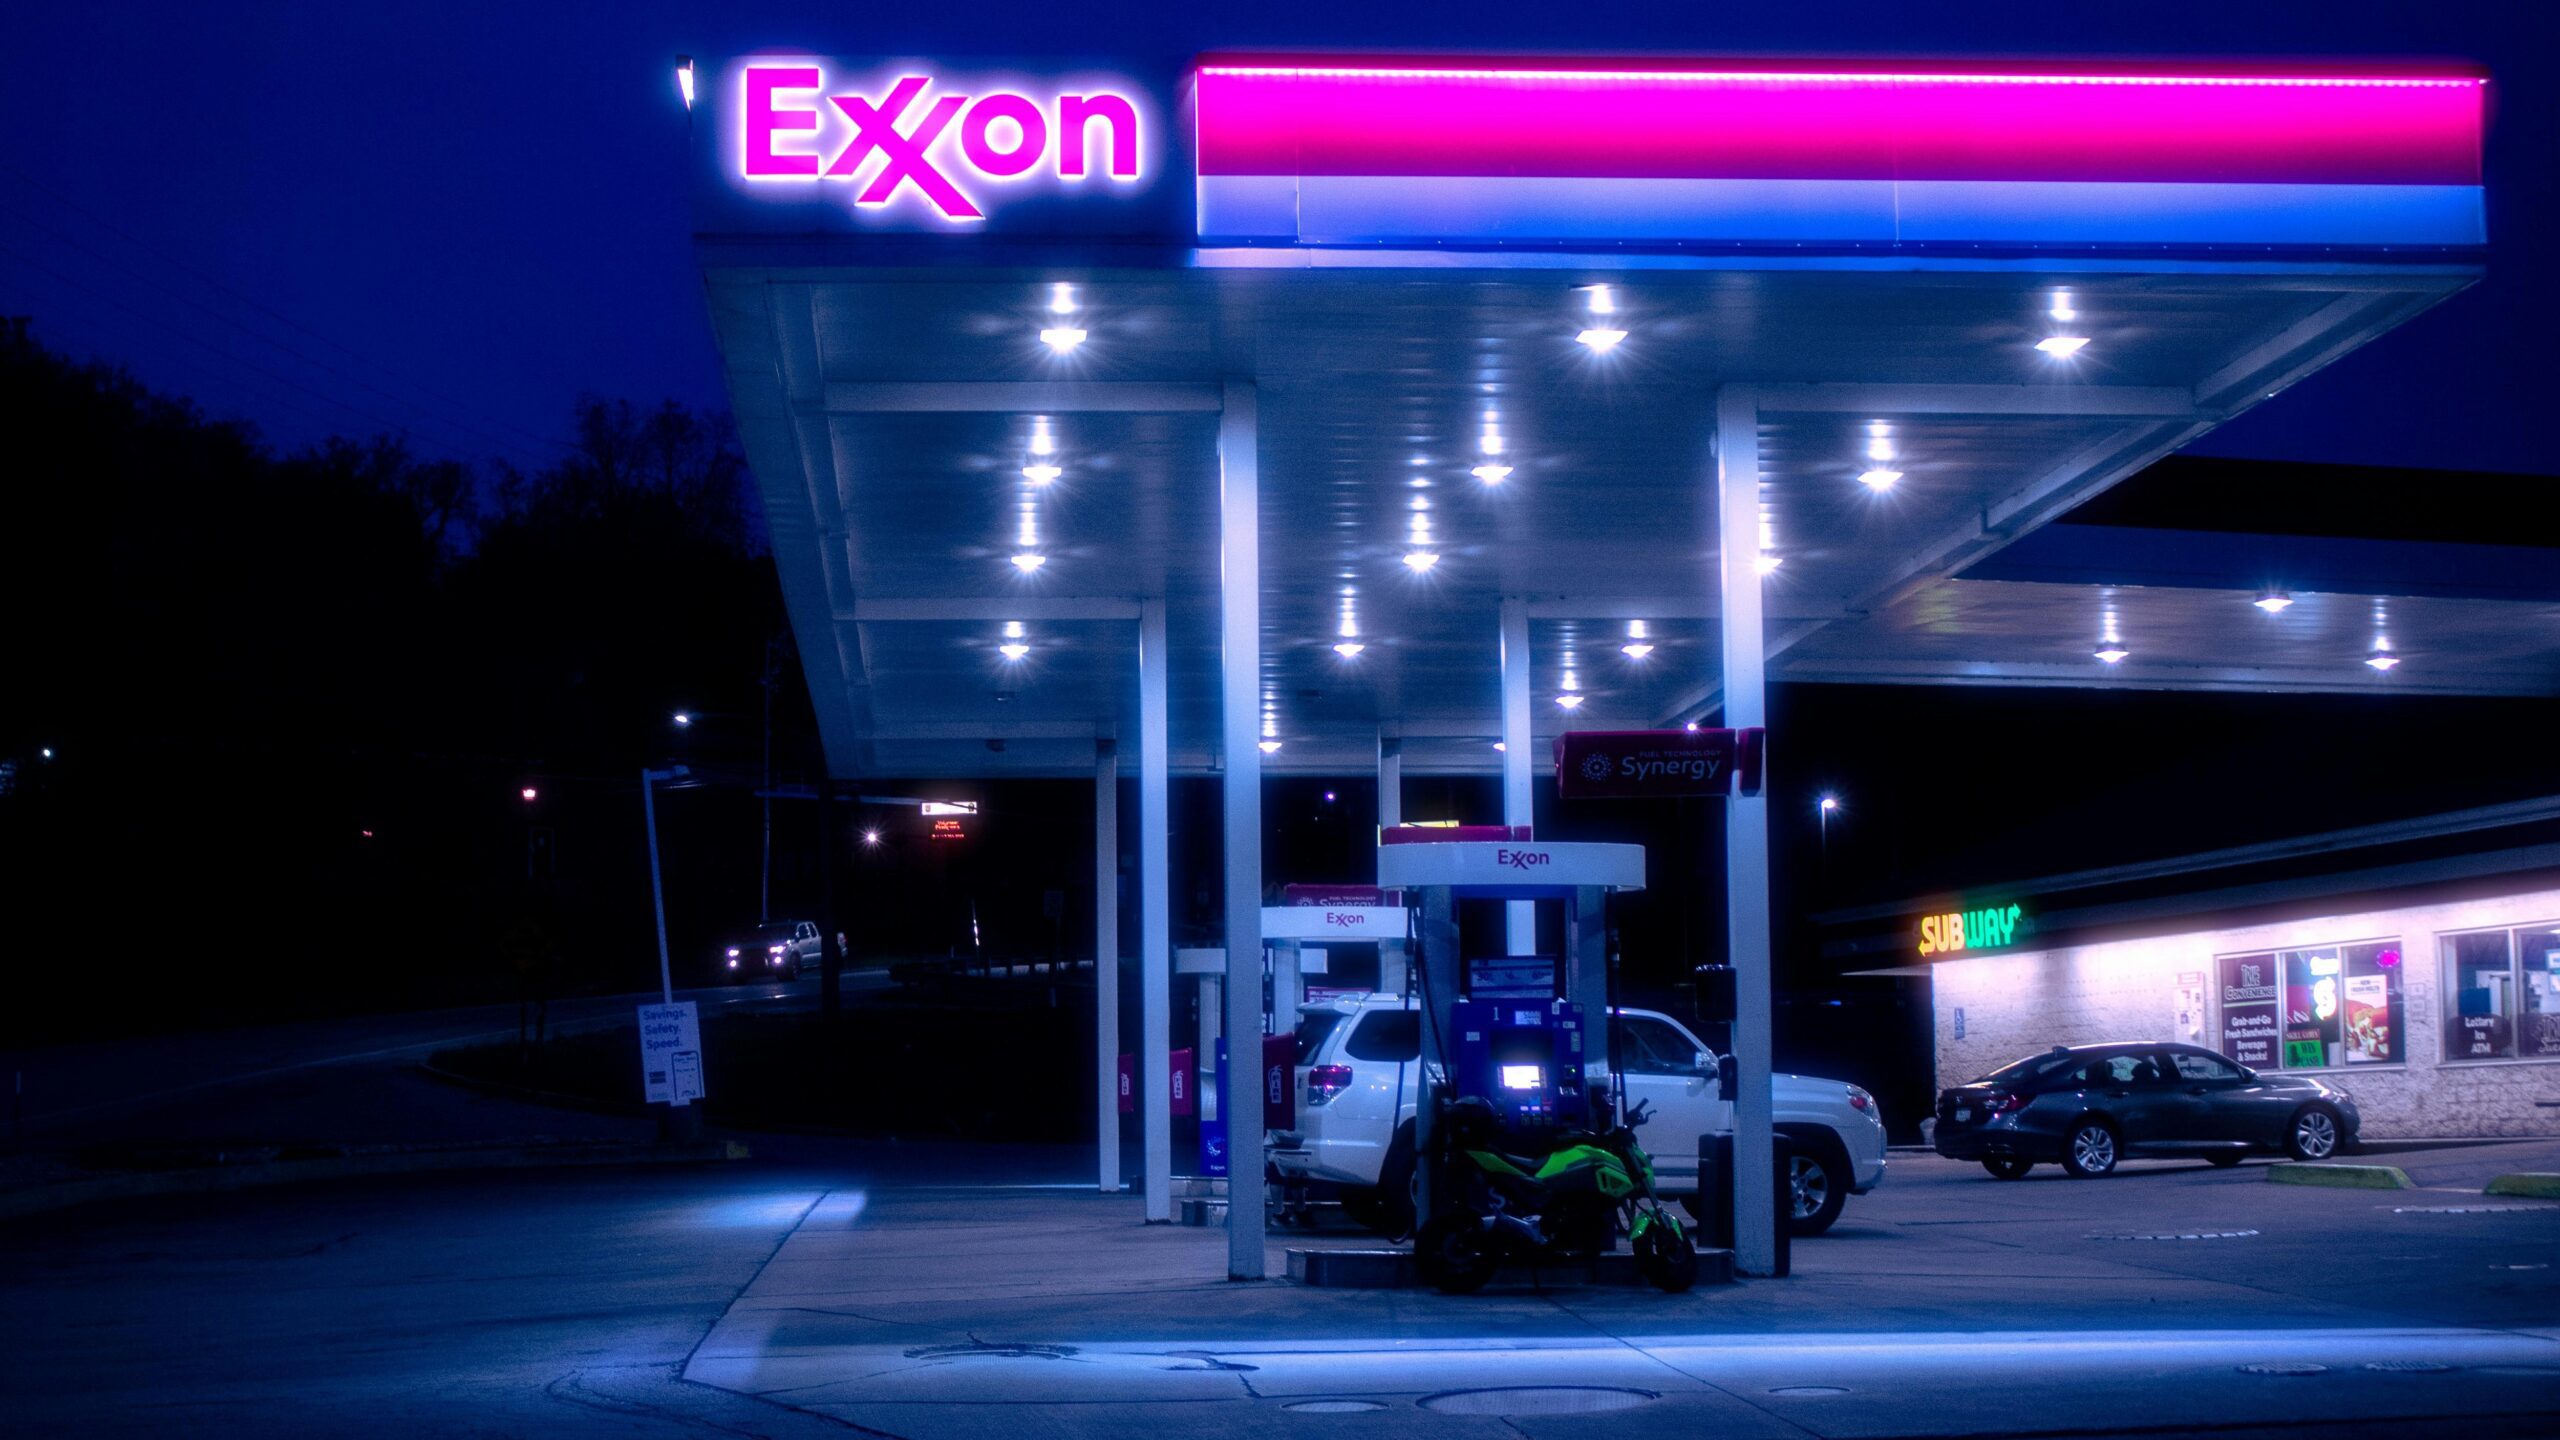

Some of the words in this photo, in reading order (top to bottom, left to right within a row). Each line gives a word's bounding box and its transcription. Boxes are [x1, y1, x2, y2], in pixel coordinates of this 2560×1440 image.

[745, 66, 1139, 218] Exxon
[1663, 750, 1721, 758] TECHNOLOGY
[1621, 756, 1721, 781] Synergy
[1498, 849, 1550, 870] Exxon
[1327, 912, 1365, 927] Exxon
[1918, 903, 2021, 957] SUBWAY
[643, 1009, 687, 1021] Savings.
[1493, 1006, 1500, 1021] 1
[2231, 1014, 2272, 1027] Grab-and-Go
[644, 1023, 681, 1035] Safety.
[2465, 1017, 2494, 1028] Lottery
[646, 1036, 682, 1051] Speed.
[2236, 1040, 2267, 1050] Beverages
[2471, 1042, 2492, 1053] ATM
